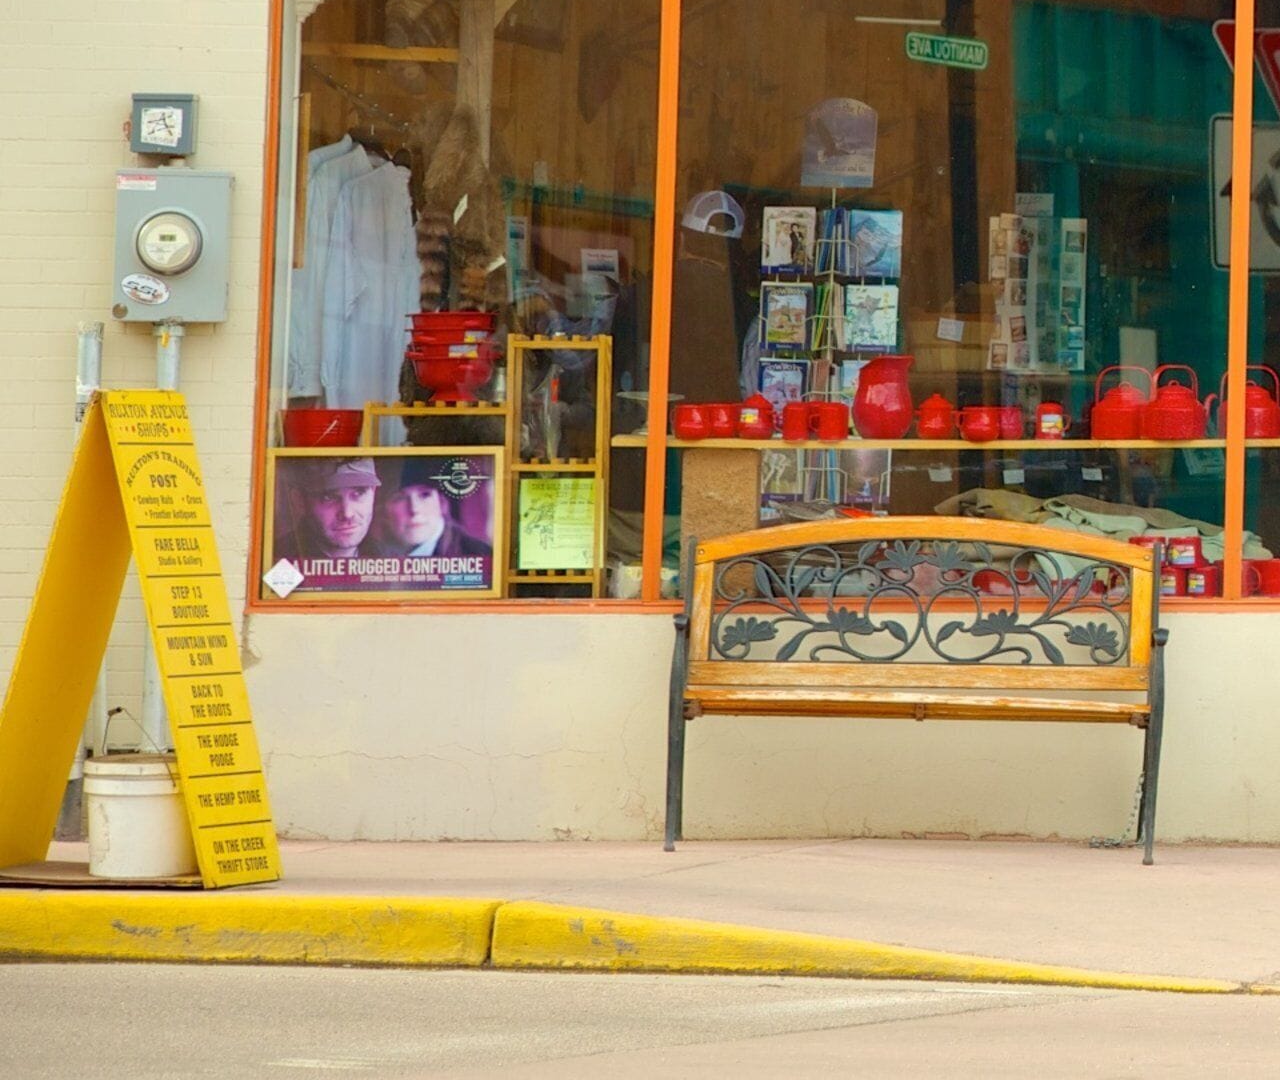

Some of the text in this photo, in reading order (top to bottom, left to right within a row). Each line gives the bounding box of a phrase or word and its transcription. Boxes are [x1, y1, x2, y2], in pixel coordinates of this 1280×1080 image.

[108, 403, 189, 420] RUXTON AVENUE
[137, 422, 169, 438] SHOPS
[126, 450, 202, 488] RUXTON'S TRADING
[150, 474, 177, 489] POST
[137, 495, 160, 507] Cowboy
[172, 509, 197, 524] Antiques
[154, 537, 200, 552] FARE BELLA
[158, 556, 177, 567] Studio
[182, 555, 203, 568] Gallery
[303, 558, 345, 576] LITTLE
[348, 558, 399, 576] RUGGED
[403, 557, 484, 575] CONFIDENCE
[171, 586, 202, 600] STEP 13
[172, 605, 210, 620] BOUTIQUE
[166, 634, 228, 651] MOUNTAIN WIND
[189, 652, 214, 667] & SUN
[191, 684, 223, 699] BACK TO
[191, 703, 232, 719] THE ROOTS
[197, 733, 240, 749] THE HODGE
[210, 752, 236, 768] PODGE
[198, 789, 262, 809] THE HEMP STORE
[213, 836, 266, 855] ON THE CREEK
[216, 855, 269, 874] THRIFT STORE
